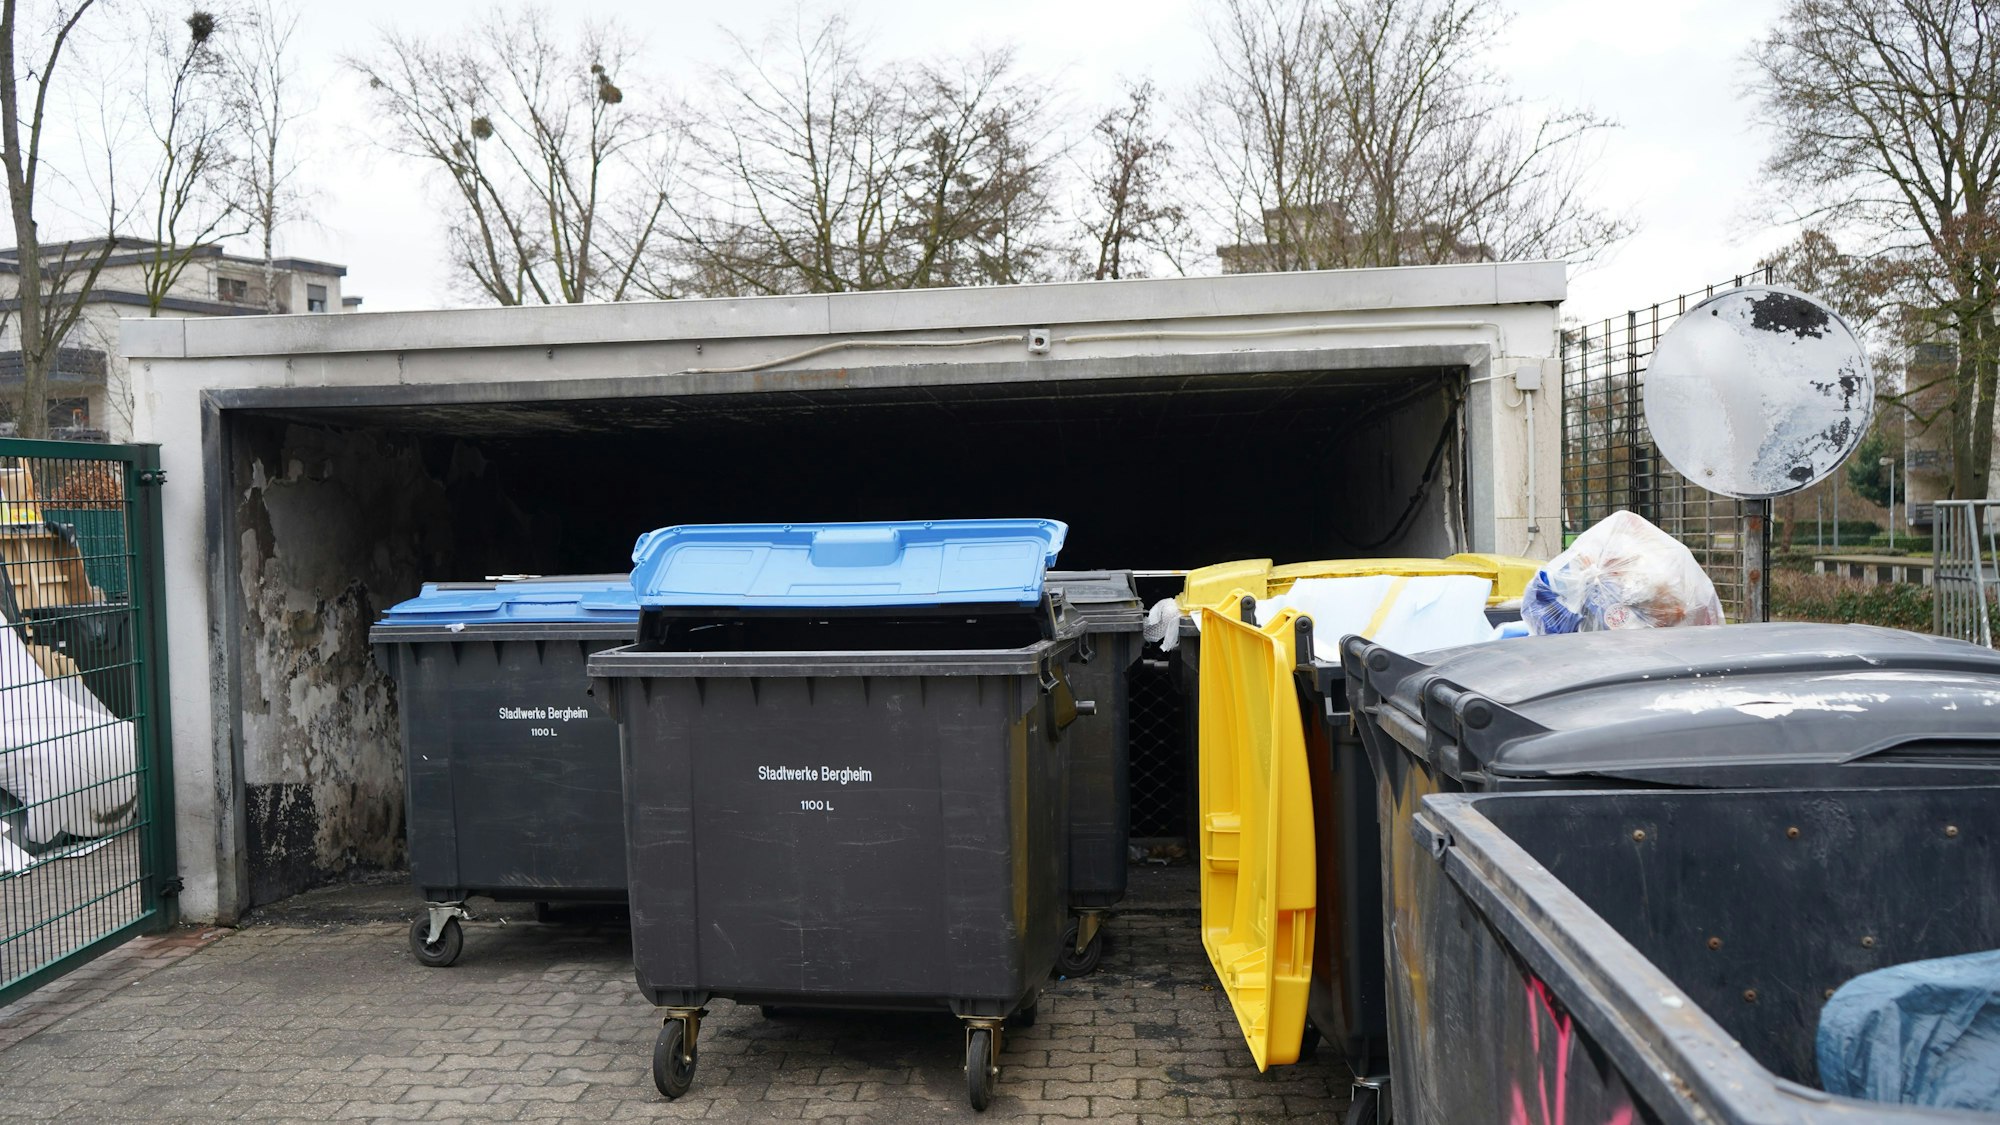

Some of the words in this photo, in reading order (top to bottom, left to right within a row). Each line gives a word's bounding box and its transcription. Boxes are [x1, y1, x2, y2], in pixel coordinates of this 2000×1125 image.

[498, 706, 546, 720] Stadtwerke
[547, 706, 589, 722] Bergheim
[530, 727, 549, 737] 1100
[550, 727, 558, 737] L
[758, 765, 818, 781] Stadtwerke
[821, 765, 872, 785] Bergheim
[800, 800, 824, 811] 1100
[826, 800, 834, 811] L
